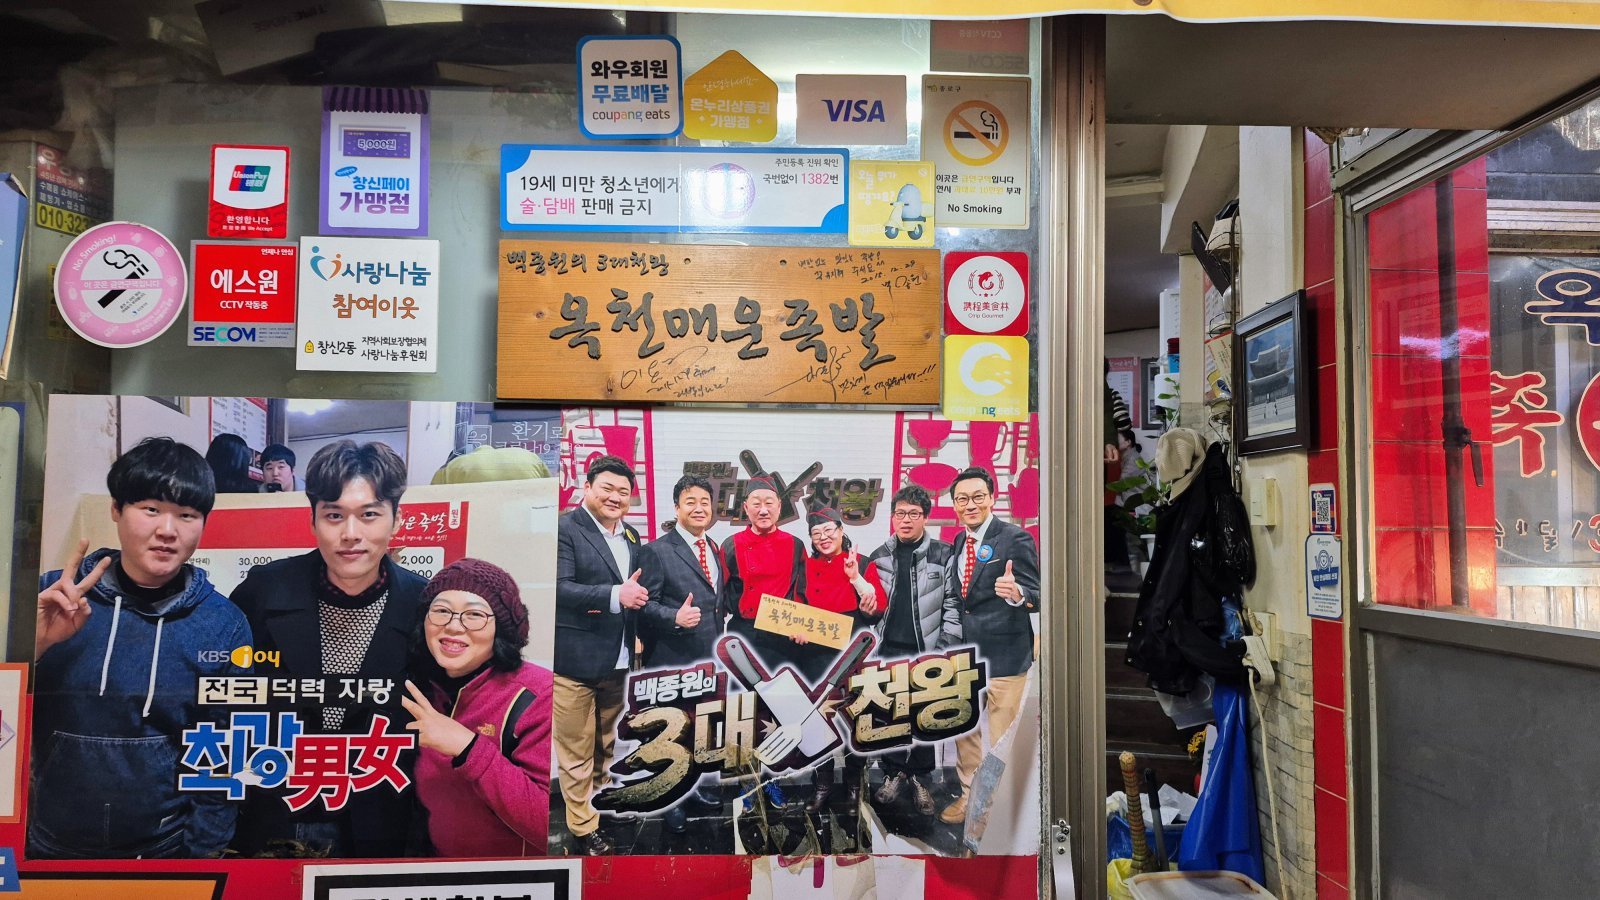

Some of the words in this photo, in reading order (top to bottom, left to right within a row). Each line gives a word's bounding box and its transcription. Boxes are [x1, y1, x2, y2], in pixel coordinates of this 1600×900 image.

[591, 60, 668, 79] 와우회원
[592, 84, 670, 104] 무료배달
[690, 98, 771, 115] 온누리상품권
[821, 99, 886, 123] VISA
[592, 109, 643, 123] coupang
[645, 109, 671, 120] eats
[710, 115, 750, 129] 가맹점
[358, 139, 396, 152] 5,000원
[775, 158, 805, 168] 주민등록
[807, 158, 822, 168] 진위
[823, 158, 839, 168] 확인
[233, 171, 268, 181] UnionPay
[352, 176, 410, 191] 창신페이
[520, 175, 556, 192] 19세
[562, 176, 594, 193] 미만
[763, 174, 798, 185] 국번없이
[801, 172, 840, 185] 1382번
[935, 174, 959, 184] 이곳은
[935, 185, 951, 195] 연시
[1006, 186, 1022, 196] 부과
[339, 192, 410, 215] 가맹점
[520, 197, 575, 215] 술·담배
[581, 197, 614, 216] 판매
[619, 198, 651, 216] 금지
[947, 204, 960, 214] No
[963, 204, 1003, 216] Smoking
[226, 215, 270, 225] 환영합니다
[72, 260, 84, 271] No
[80, 234, 117, 259] Smoking!
[507, 250, 588, 275] 백종원의
[341, 261, 431, 286] 사랑나눔
[210, 269, 279, 295] 에스원
[219, 300, 245, 309] CCTV
[245, 300, 269, 310] 작동중
[332, 293, 420, 320] 참여이웃
[193, 327, 256, 343] SECOM
[361, 336, 427, 348] 지역사회보장협의체
[317, 341, 357, 356] 창신2동
[361, 349, 428, 362] 사랑나눔후원회
[418, 511, 448, 534] 족발
[450, 508, 459, 526] 원조
[239, 556, 272, 566] 30,000
[198, 650, 230, 663] KBS
[204, 678, 259, 704] 전국
[271, 678, 325, 704] 덕력
[338, 678, 395, 704] 자랑
[633, 669, 717, 703] 백종원의
[848, 653, 980, 745] 천왕
